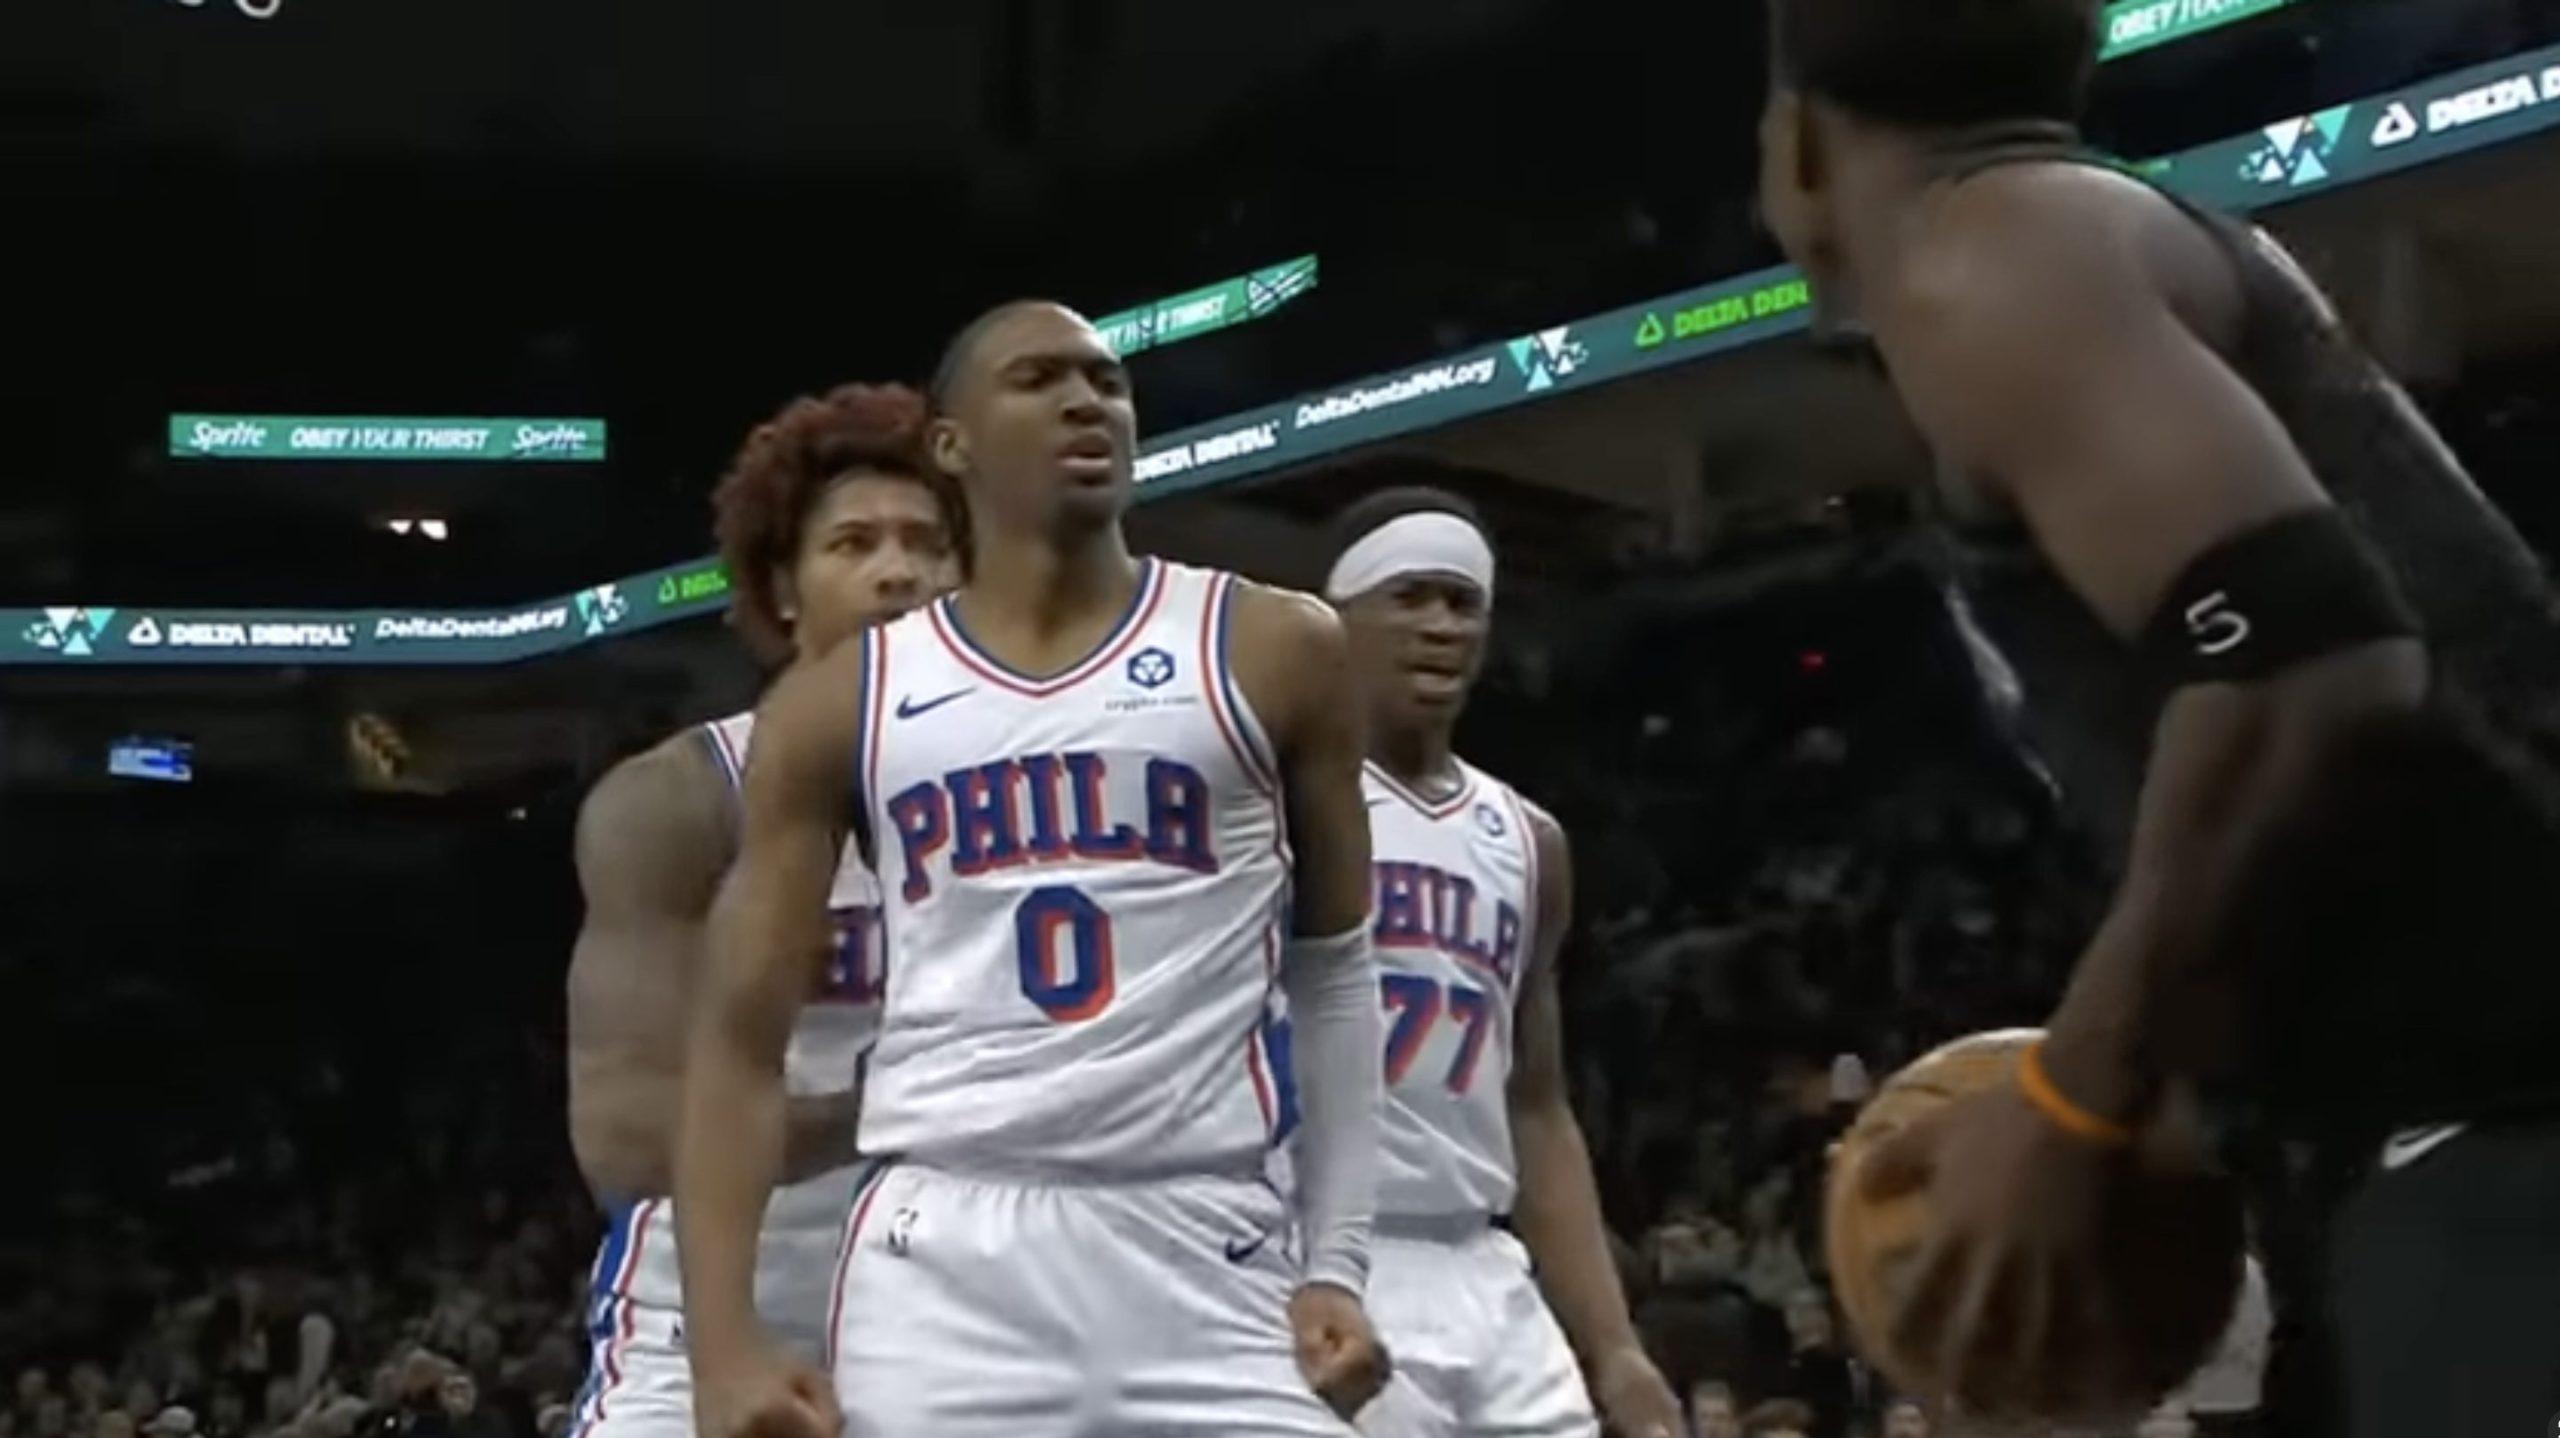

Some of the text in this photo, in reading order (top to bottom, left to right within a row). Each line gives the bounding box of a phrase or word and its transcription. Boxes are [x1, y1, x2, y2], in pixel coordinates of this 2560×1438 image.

[2426, 74, 2538, 133] DELTA
[1673, 279, 1808, 339] DELTA DEN
[189, 421, 268, 452] Sprite
[290, 427, 350, 449] OBEY
[413, 427, 490, 450] THIRST
[168, 623, 248, 647] DELTA
[2185, 589, 2249, 654] 5
[887, 751, 1220, 904] PHILA
[1015, 885, 1116, 1024] 0
[1373, 861, 1520, 989] HILA
[1380, 973, 1488, 1096] 77
